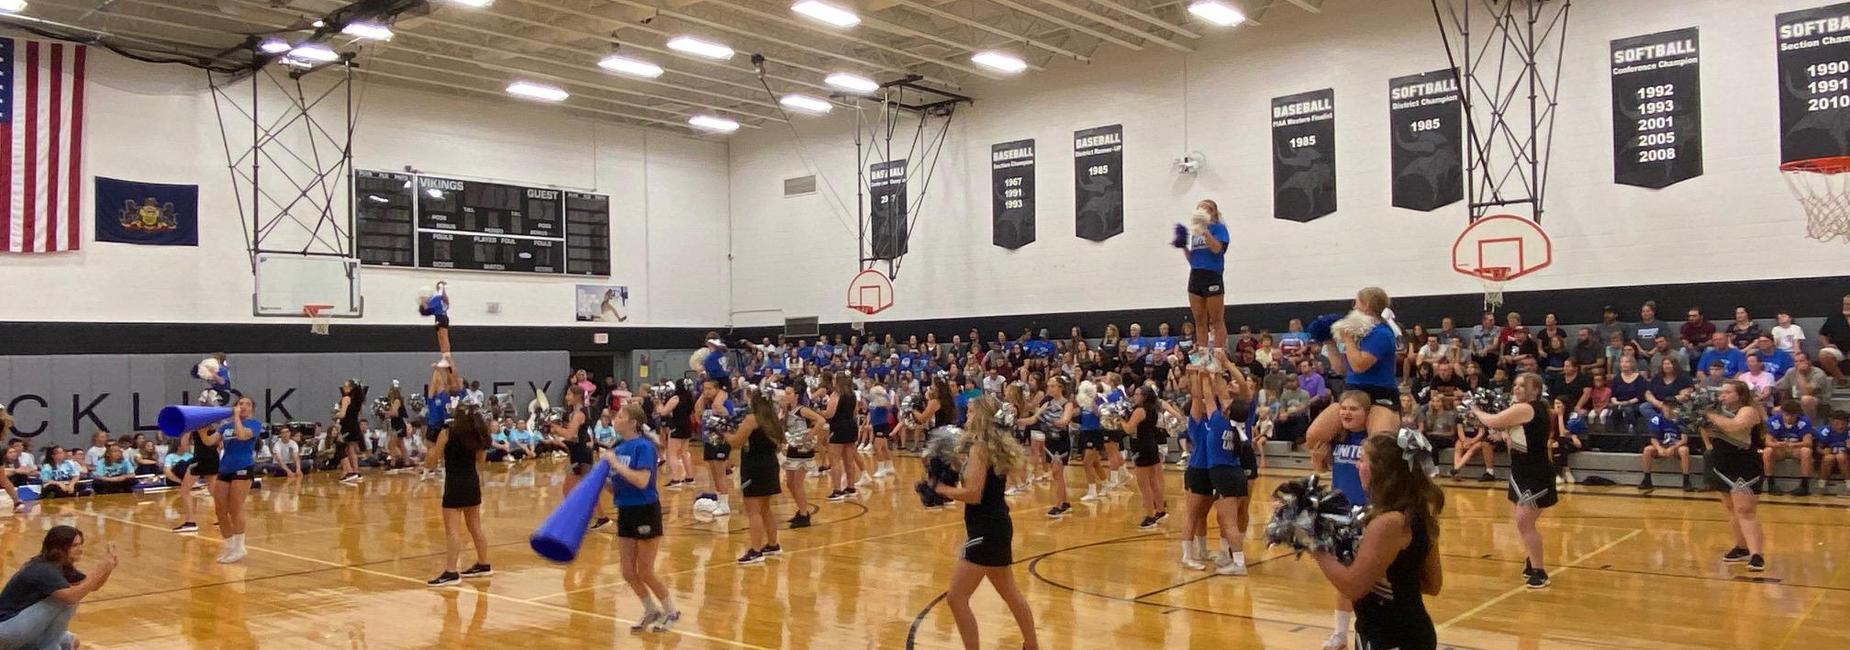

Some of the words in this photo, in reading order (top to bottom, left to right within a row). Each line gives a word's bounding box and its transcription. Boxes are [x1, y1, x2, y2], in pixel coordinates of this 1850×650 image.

[1614, 40, 1695, 63] SOFTBALL
[1781, 39, 1819, 51] Section
[1613, 64, 1657, 75] Conference
[1658, 57, 1698, 68] Champion
[1807, 60, 1849, 77] 1990
[1392, 78, 1458, 99] SOFTBALL
[1638, 84, 1674, 99] 1992
[1808, 77, 1848, 94] 1991
[1273, 98, 1332, 118] BASEBALL
[1392, 100, 1419, 110] District
[1421, 95, 1457, 105] Champion
[1638, 100, 1674, 114] 1993
[1808, 95, 1850, 111] 2010
[1410, 118, 1440, 132] 1985
[1638, 116, 1673, 131] 2001
[1075, 133, 1121, 150] BASEBALL
[1289, 135, 1316, 148] 1985
[1638, 132, 1675, 147] 2005
[993, 147, 1033, 162] BASEBALL
[1639, 148, 1676, 162] 2008
[1088, 164, 1108, 176] 1985
[420, 177, 464, 191] VIKINGS
[527, 189, 558, 200] GUEST
[1005, 188, 1022, 198] 1991
[1005, 199, 1023, 209] 1993
[1333, 444, 1365, 458] UNITE
